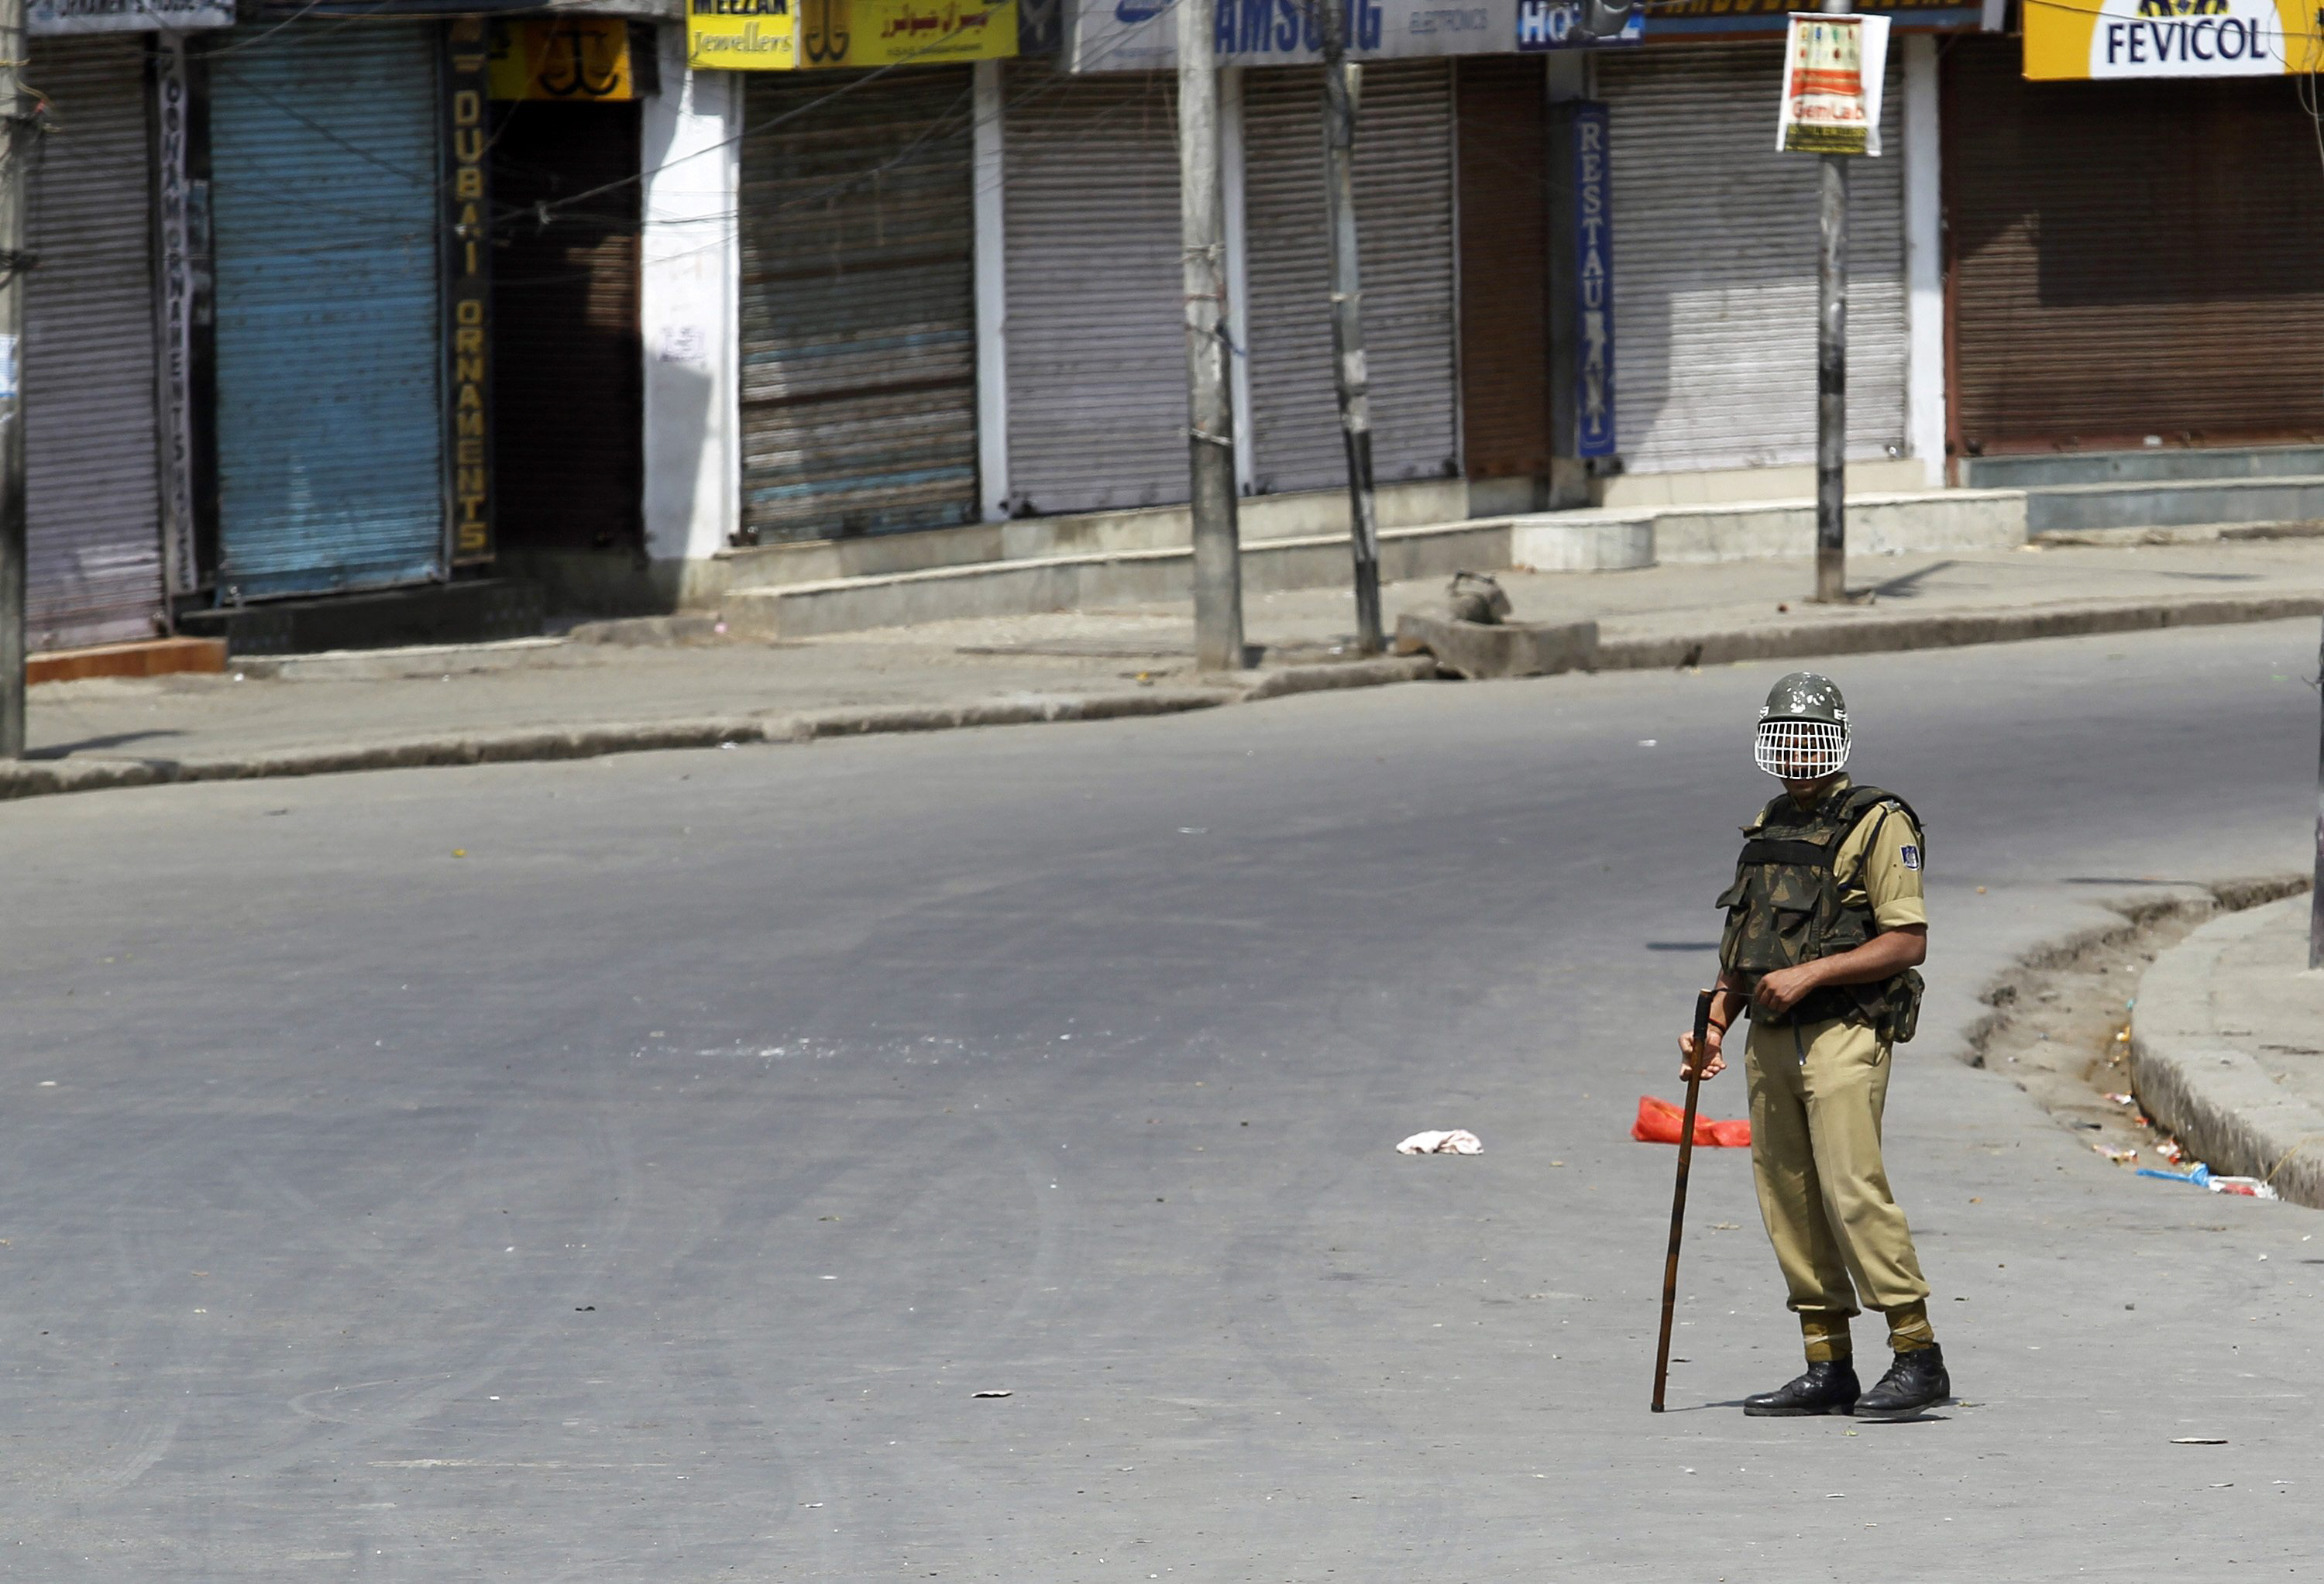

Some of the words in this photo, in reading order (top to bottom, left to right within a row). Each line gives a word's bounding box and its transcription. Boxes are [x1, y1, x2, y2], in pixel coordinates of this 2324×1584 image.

[692, 21, 791, 58] Jewellers
[2107, 19, 2267, 64] FEVICOL
[454, 90, 483, 275] DUBAI
[1579, 122, 1607, 435] RESTAURANT
[456, 300, 486, 548] ORNAMENTS
